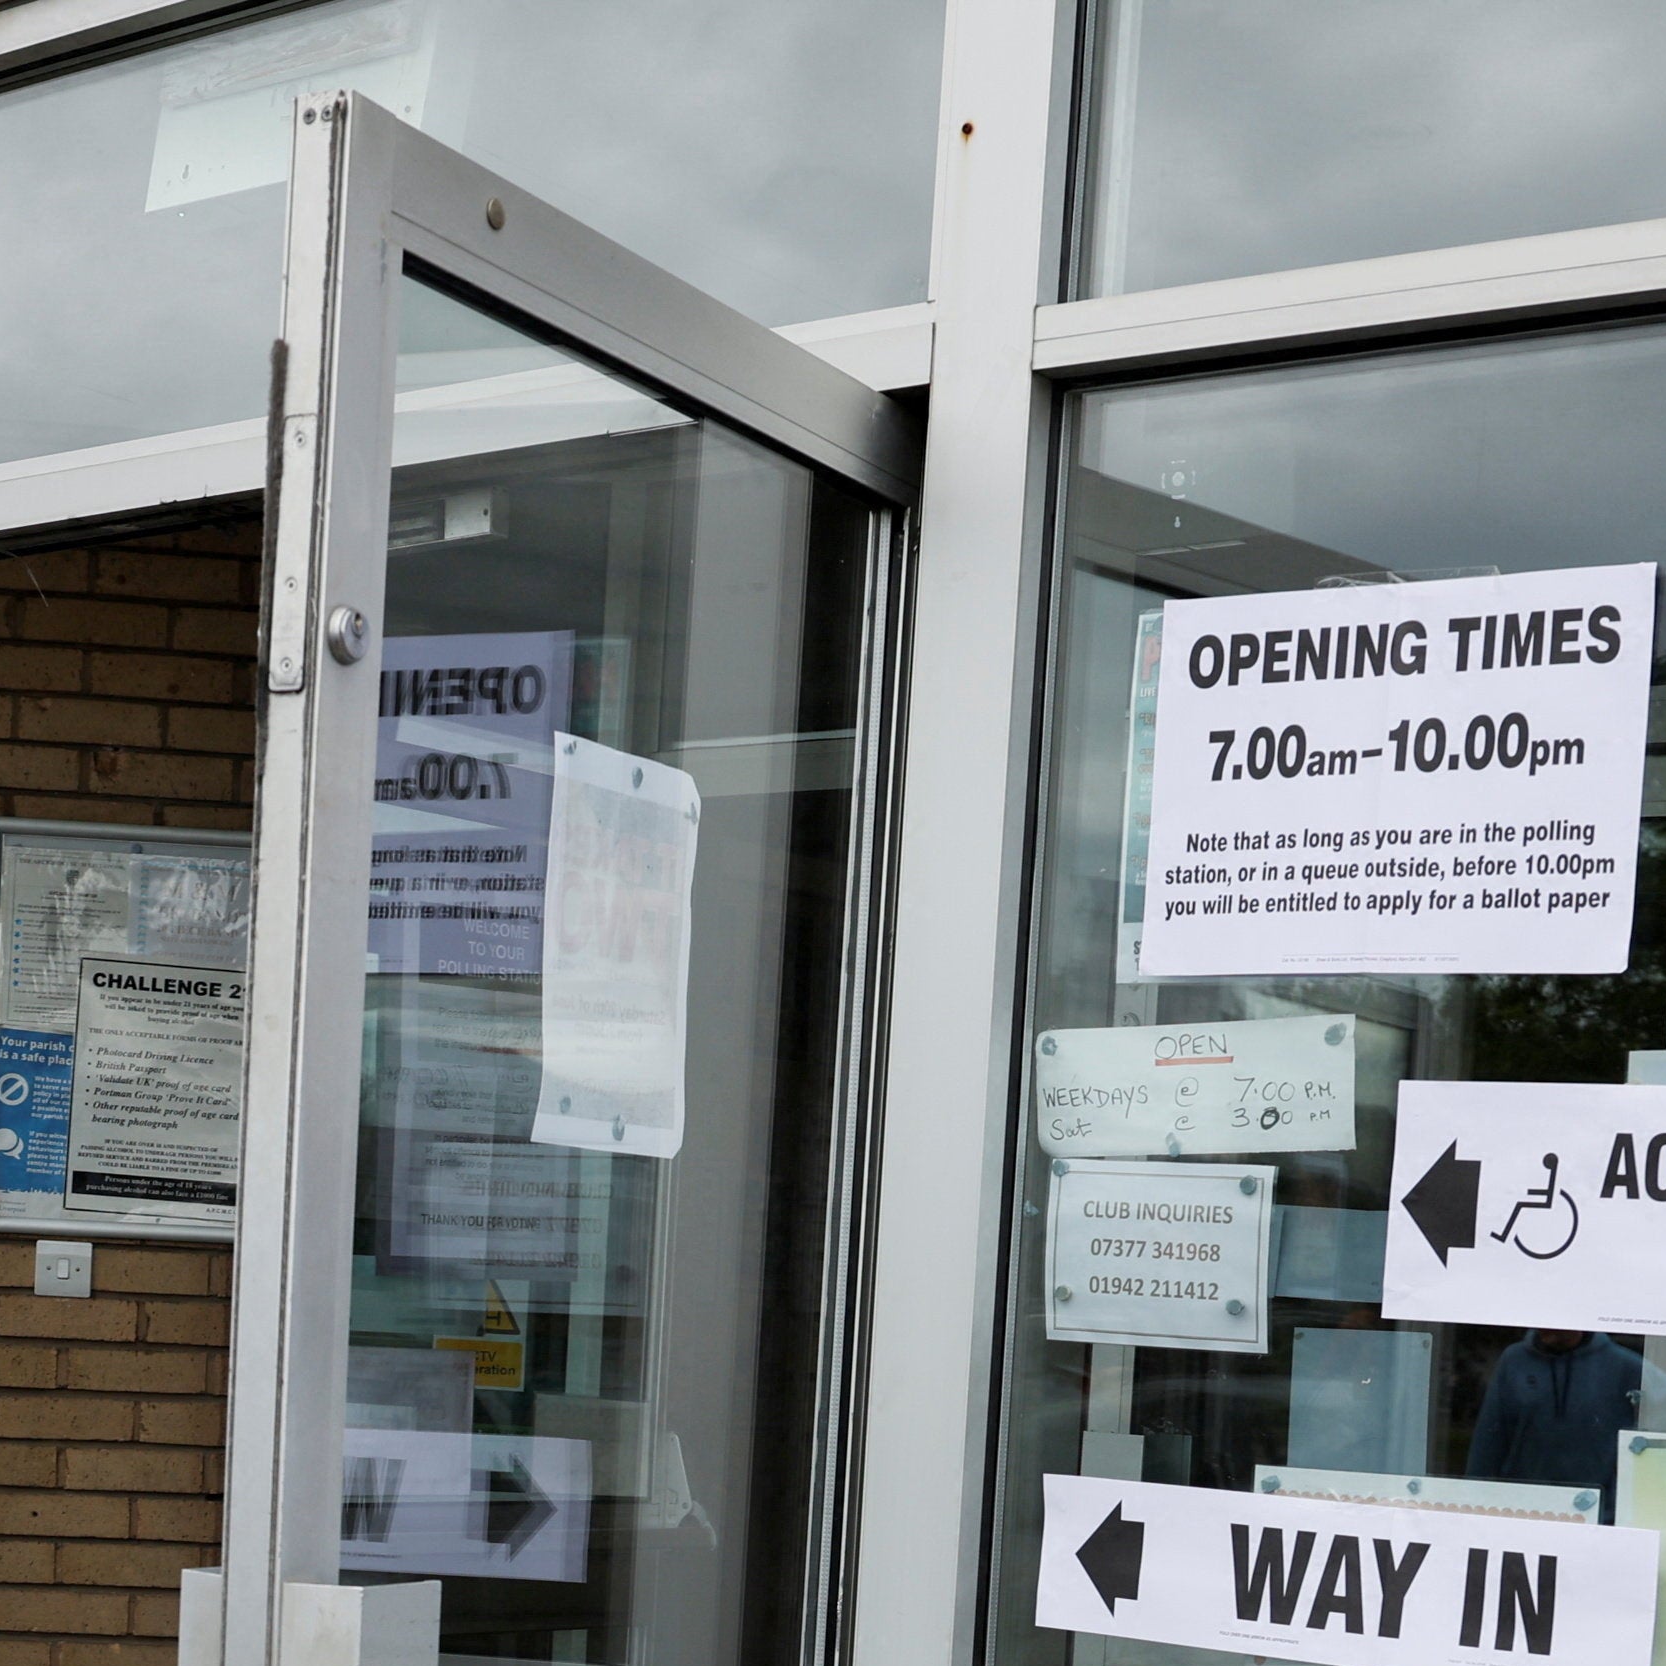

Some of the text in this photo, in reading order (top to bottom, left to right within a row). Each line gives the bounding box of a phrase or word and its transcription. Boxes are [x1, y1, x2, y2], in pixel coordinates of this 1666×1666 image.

[1188, 604, 1622, 689] OPENING TIMES
[1186, 819, 1595, 855] Note that as long as you are in the polling
[1165, 852, 1615, 888] station, or in a queue outside, before 10.00pm
[1165, 887, 1610, 921] you will be entitled to apply for a ballot paper
[464, 919, 530, 940] WELCOME
[468, 941, 525, 961] TO YOUR
[438, 960, 541, 984] POLLING STATIO
[92, 972, 245, 1000] CHALLENGE 2
[1, 1036, 65, 1052] Your parish
[97, 1047, 214, 1065] Photocard Driving Licence
[1154, 1034, 1227, 1058] OPEN
[0, 1049, 74, 1066] is a safe plac
[96, 1060, 167, 1075] British Passport
[94, 1088, 131, 1098] Portman
[135, 1091, 163, 1102] Group
[196, 1096, 204, 1104] It
[156, 1079, 179, 1090] proof
[183, 1081, 191, 1091] of
[194, 1084, 209, 1093] age
[212, 1083, 231, 1093] card
[93, 1101, 239, 1121] Other reputable proof of age card
[1042, 1084, 1149, 1123] WEEKDAYS
[92, 1114, 178, 1130] bearing photograph
[1050, 1118, 1092, 1141] Sat
[1084, 1200, 1233, 1225] CLUB INQUIRIES
[1090, 1237, 1221, 1263] 07377 341968
[1088, 1275, 1218, 1301] 01942 211412
[1231, 1523, 1557, 1655] WAY IN
